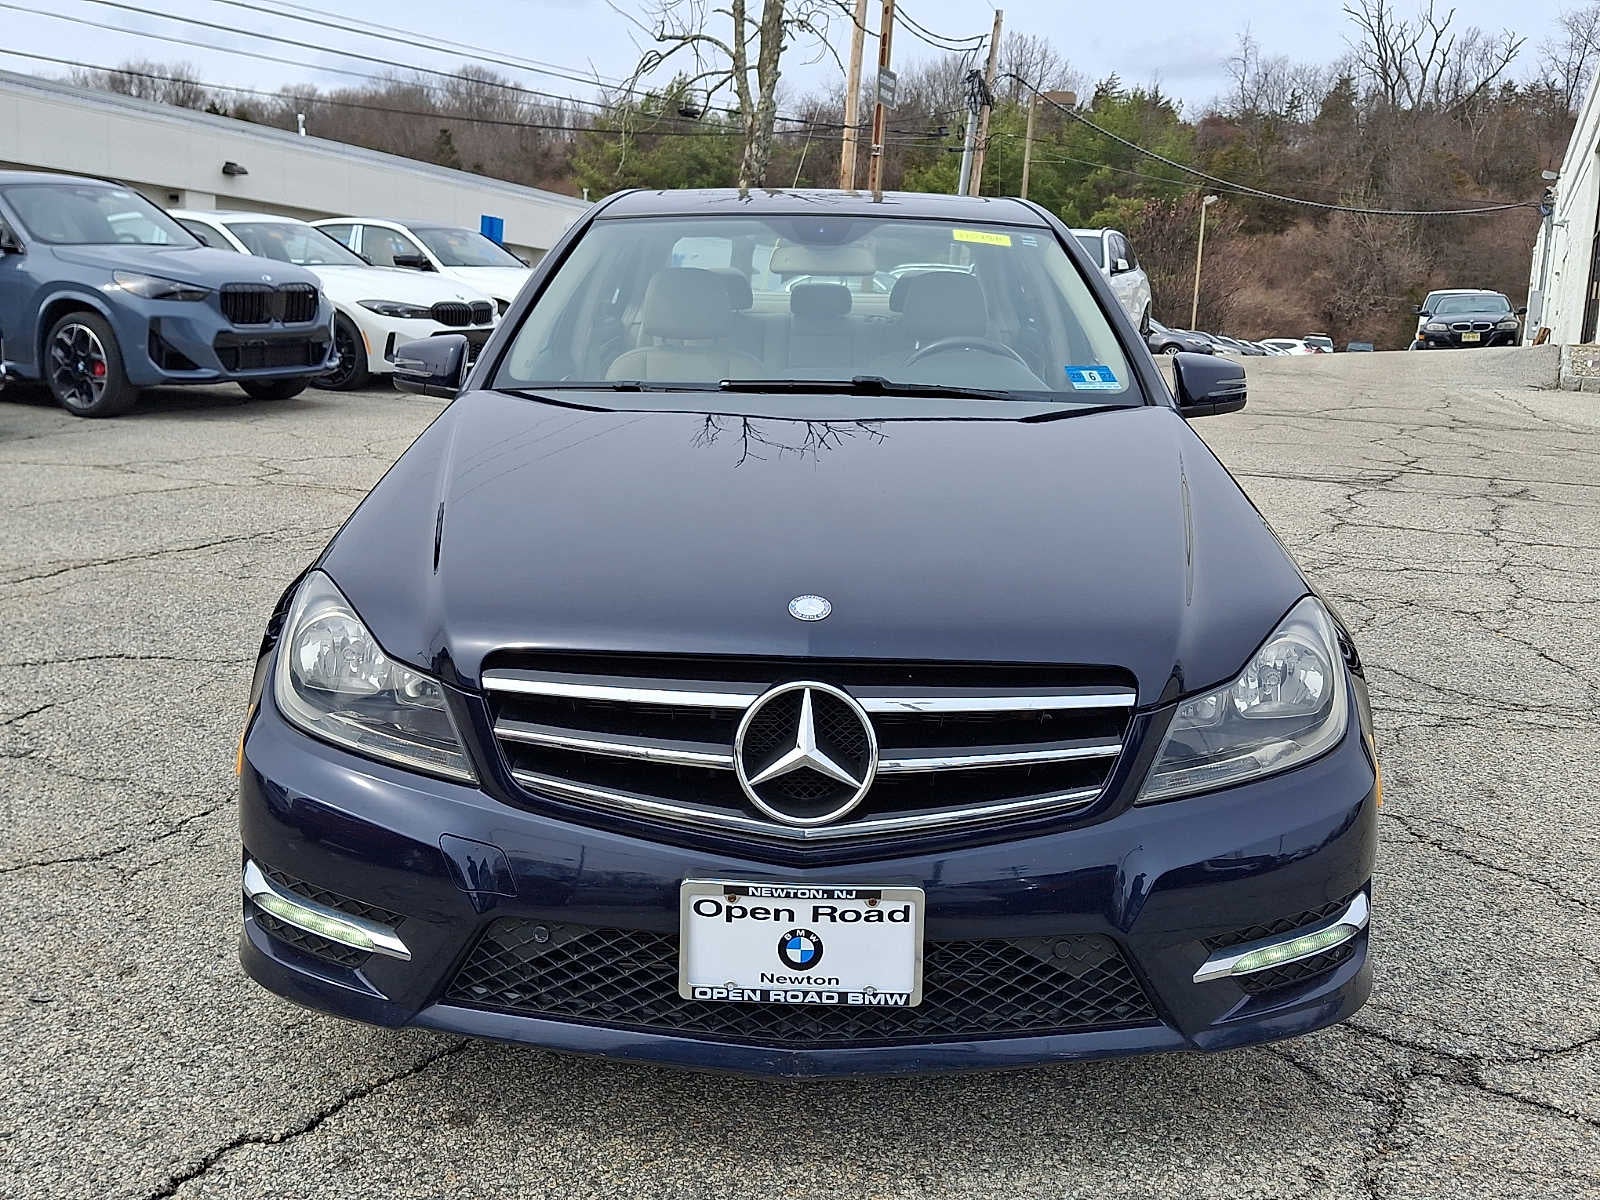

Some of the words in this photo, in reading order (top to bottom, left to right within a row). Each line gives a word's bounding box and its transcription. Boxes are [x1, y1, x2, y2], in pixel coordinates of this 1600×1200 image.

[1088, 372, 1097, 381] 6
[748, 886, 828, 899] NEWTON,
[834, 890, 856, 899] NJ
[693, 899, 795, 923] Open
[811, 904, 911, 923] Road
[784, 930, 819, 942] BMW
[760, 973, 840, 986] Newton
[694, 987, 761, 1002] OPEN
[769, 990, 839, 1004] ROAD
[847, 992, 908, 1006] BMW
